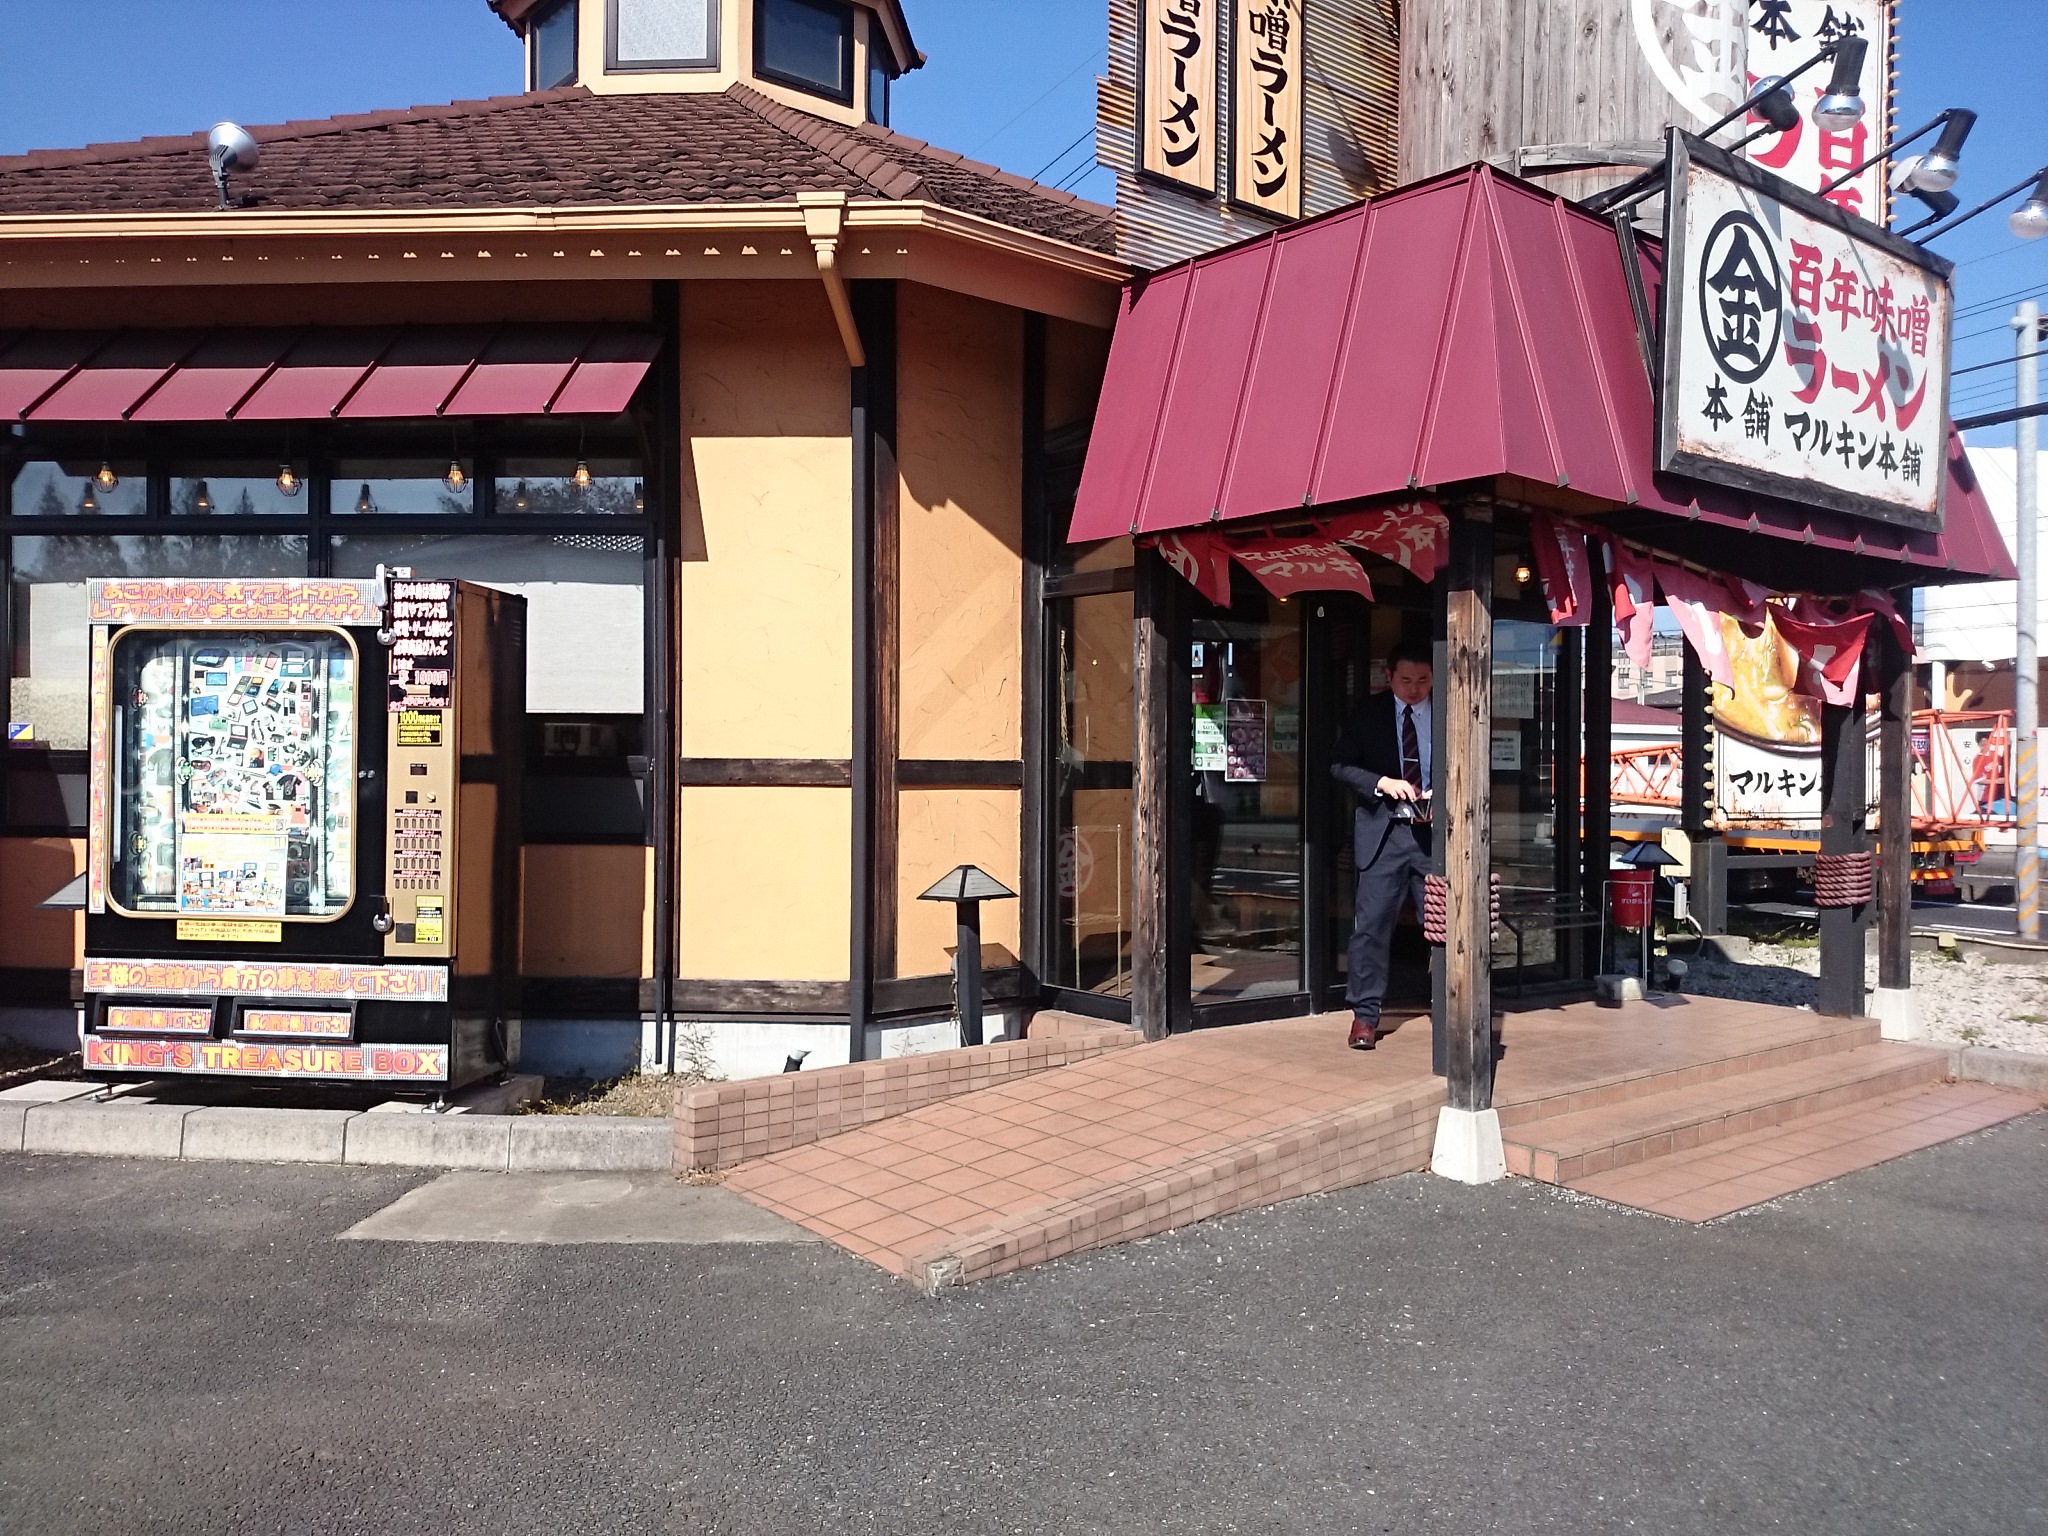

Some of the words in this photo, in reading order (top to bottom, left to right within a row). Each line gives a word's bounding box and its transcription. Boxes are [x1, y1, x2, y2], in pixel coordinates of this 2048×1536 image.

[1249, 0, 1290, 197] 噌ラーメン
[1705, 220, 1781, 372] 金
[1789, 237, 1930, 359] 百年味噌
[1701, 372, 1773, 446] 本舗
[1783, 316, 1928, 432] ラーメン
[1784, 411, 1923, 487] マルキン本舗
[103, 584, 359, 601] あこがれの人気ブランドから
[415, 671, 447, 685] 1000円
[1729, 769, 1822, 797] マルキン
[89, 1042, 192, 1067] KING'S
[201, 1046, 364, 1073] TREASURE
[372, 1050, 441, 1075] BOX
